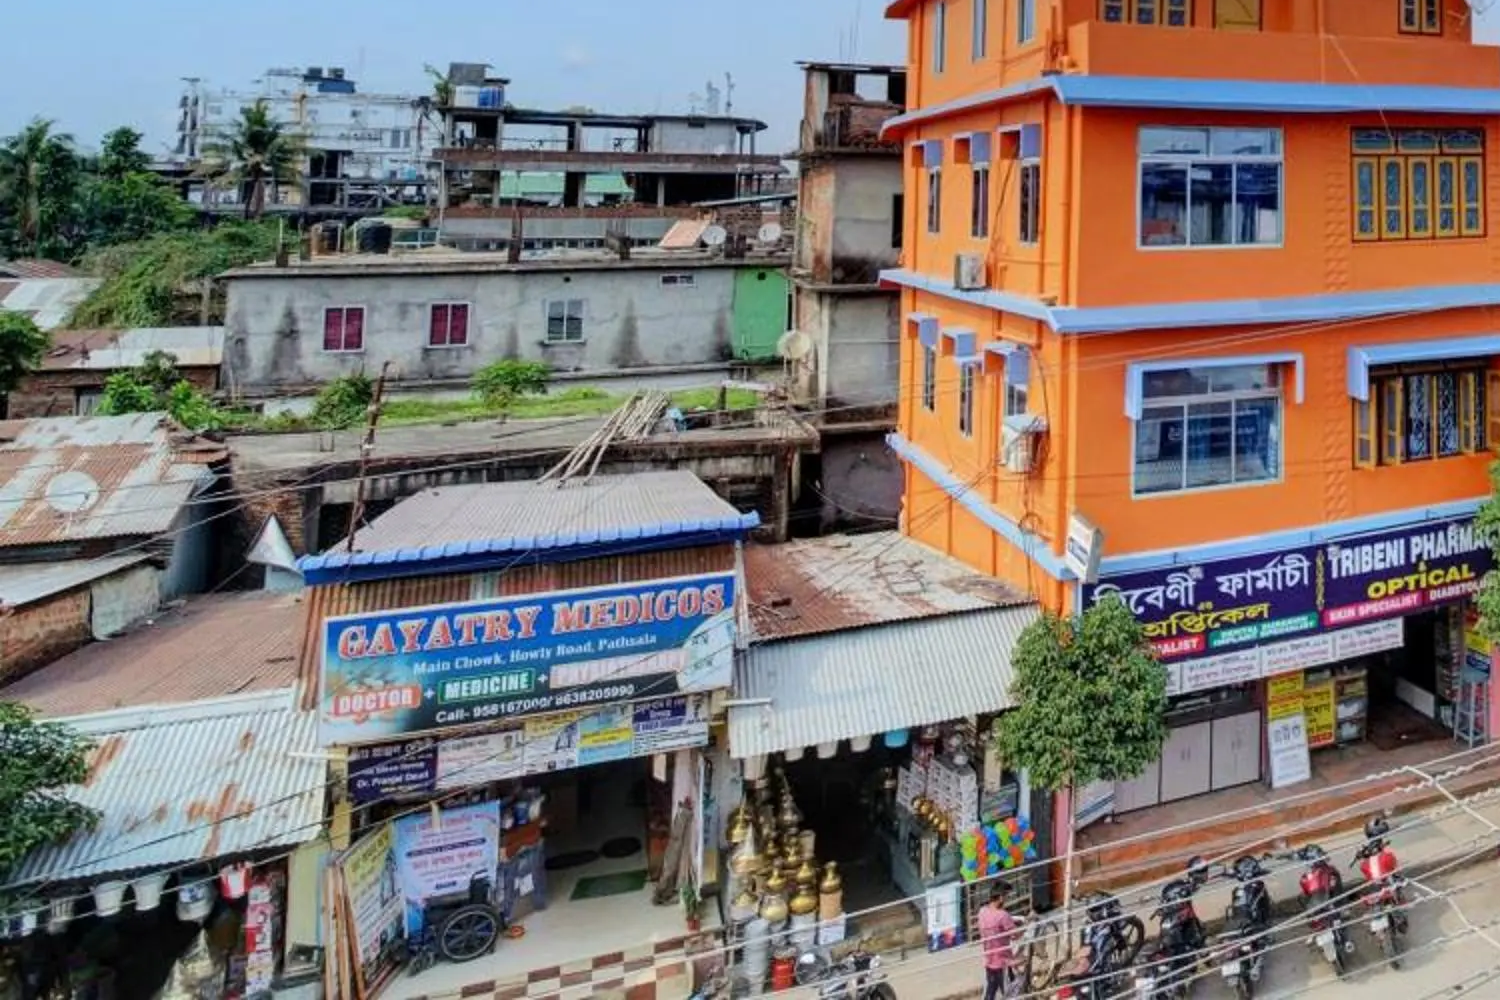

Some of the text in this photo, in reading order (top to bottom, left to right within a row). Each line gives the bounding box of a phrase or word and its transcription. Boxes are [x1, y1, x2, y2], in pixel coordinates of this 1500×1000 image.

[1328, 523, 1500, 579] TRIBENI PHARMAC
[1367, 563, 1475, 599] OPTICAL
[338, 583, 725, 660] GAYATRY MEDICOS
[1329, 593, 1420, 621] SKIN SPECIALIST
[413, 633, 657, 675] Main Chowk, Howly Road, Pathsala
[340, 686, 413, 715] DOCTOR
[444, 672, 529, 699] MEDICINE
